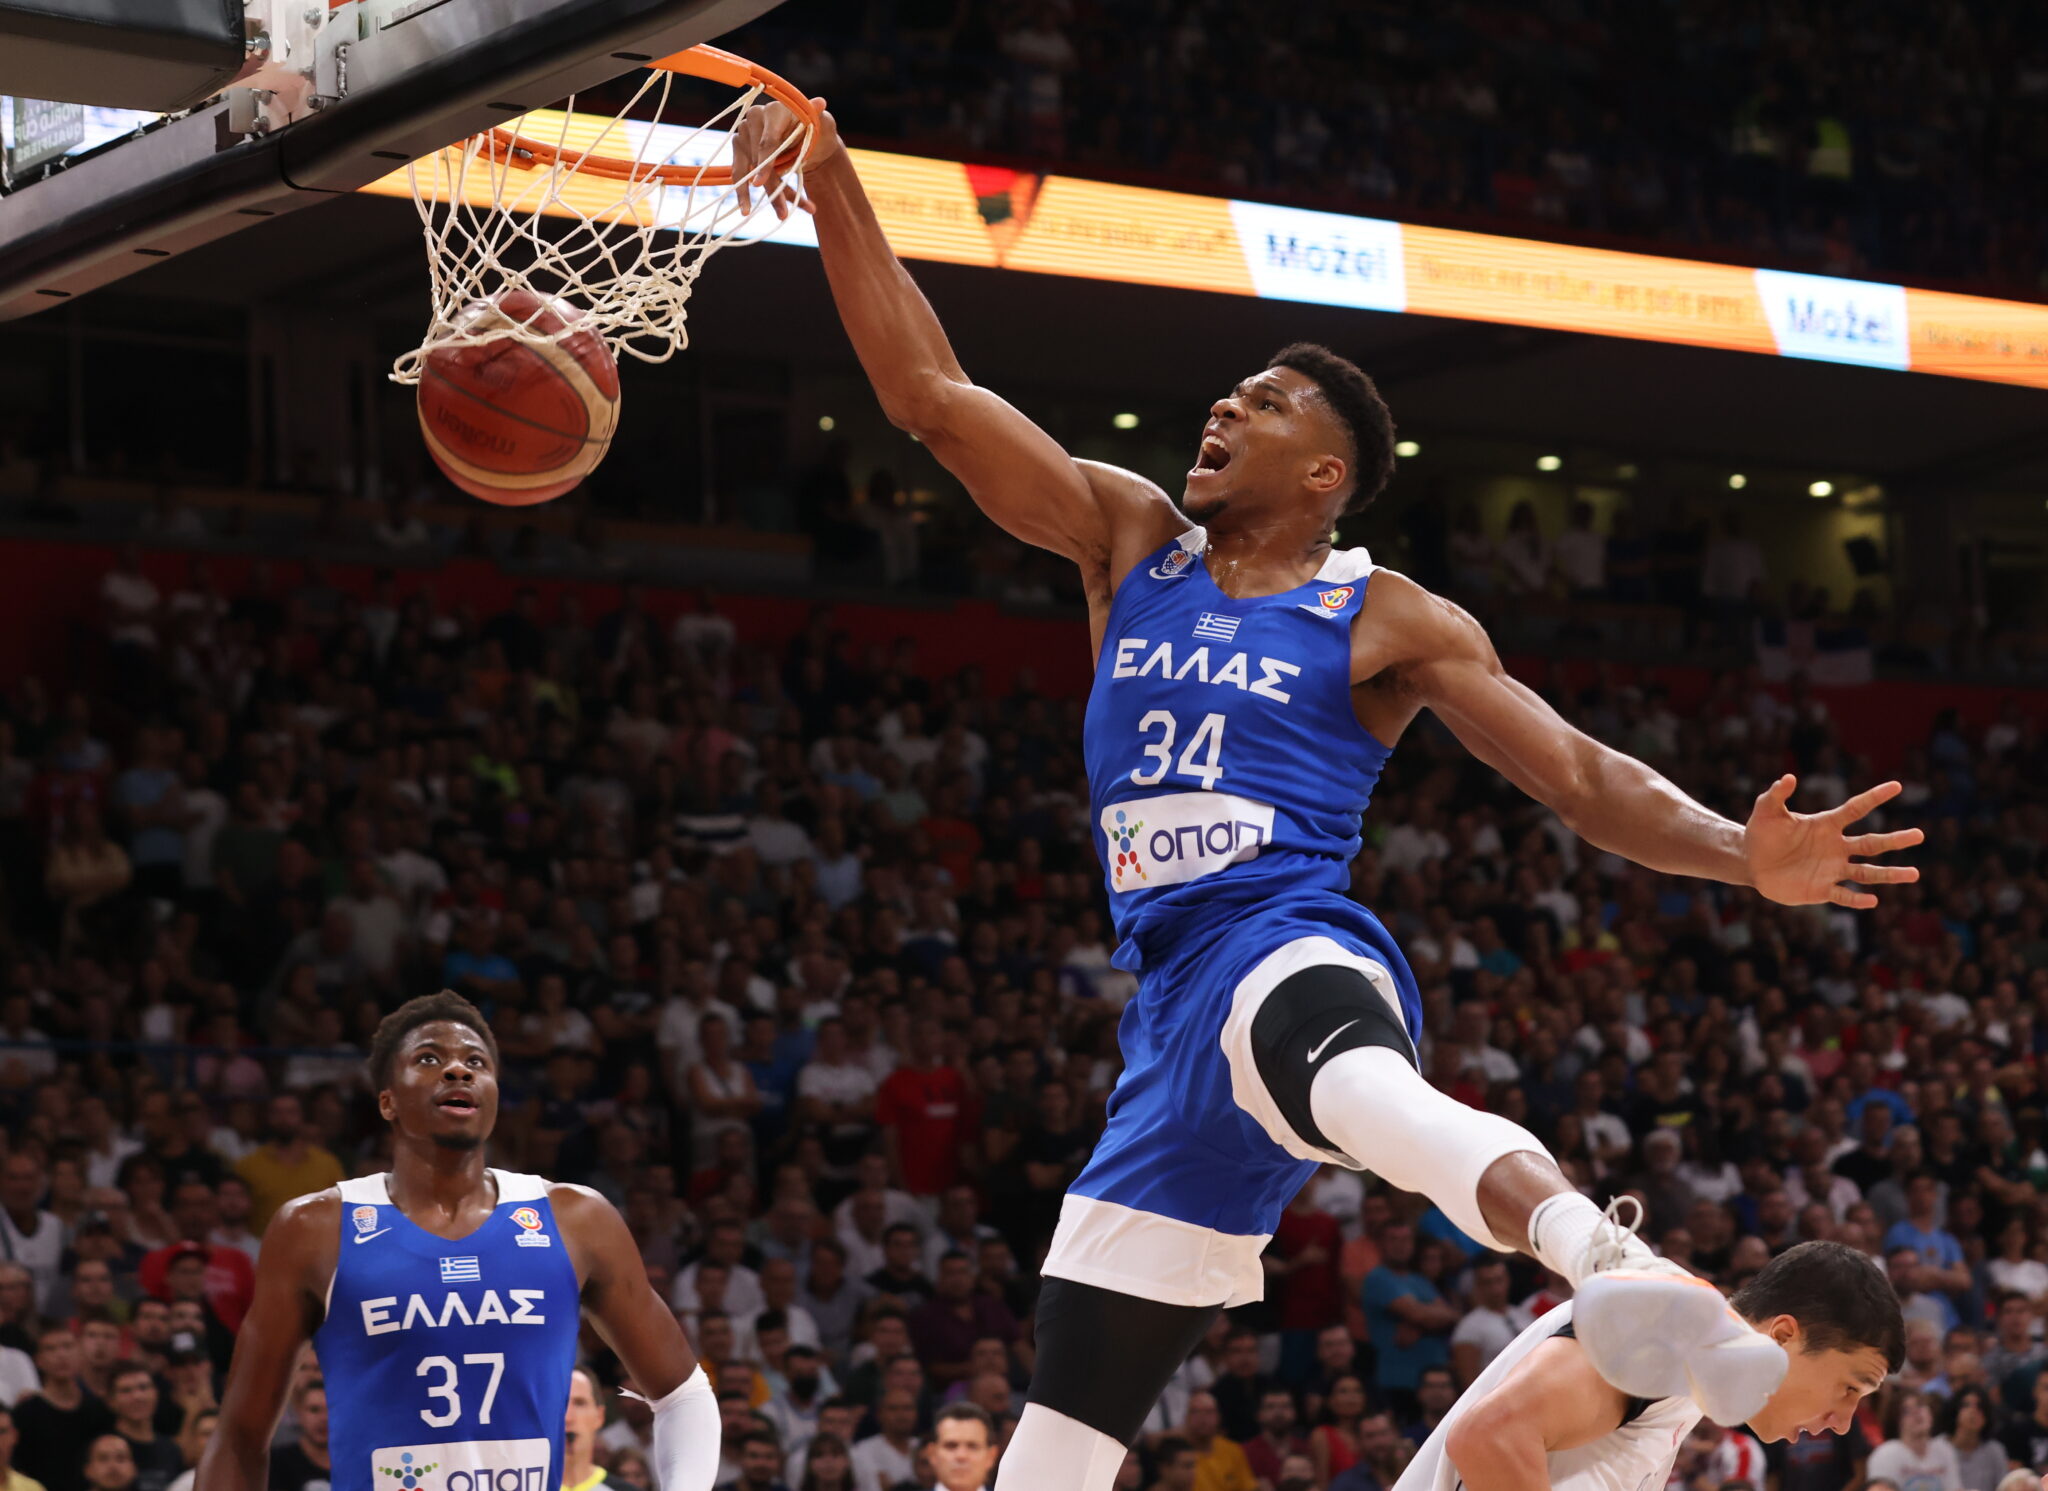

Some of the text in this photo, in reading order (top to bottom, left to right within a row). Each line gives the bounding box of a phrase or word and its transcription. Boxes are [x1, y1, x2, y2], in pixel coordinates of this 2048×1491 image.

[1112, 637, 1302, 705] ΕΛΛΑΣ
[1130, 710, 1226, 791] 34
[360, 1289, 545, 1337] ΕΛΛΑΣ
[415, 1352, 506, 1429] 37
